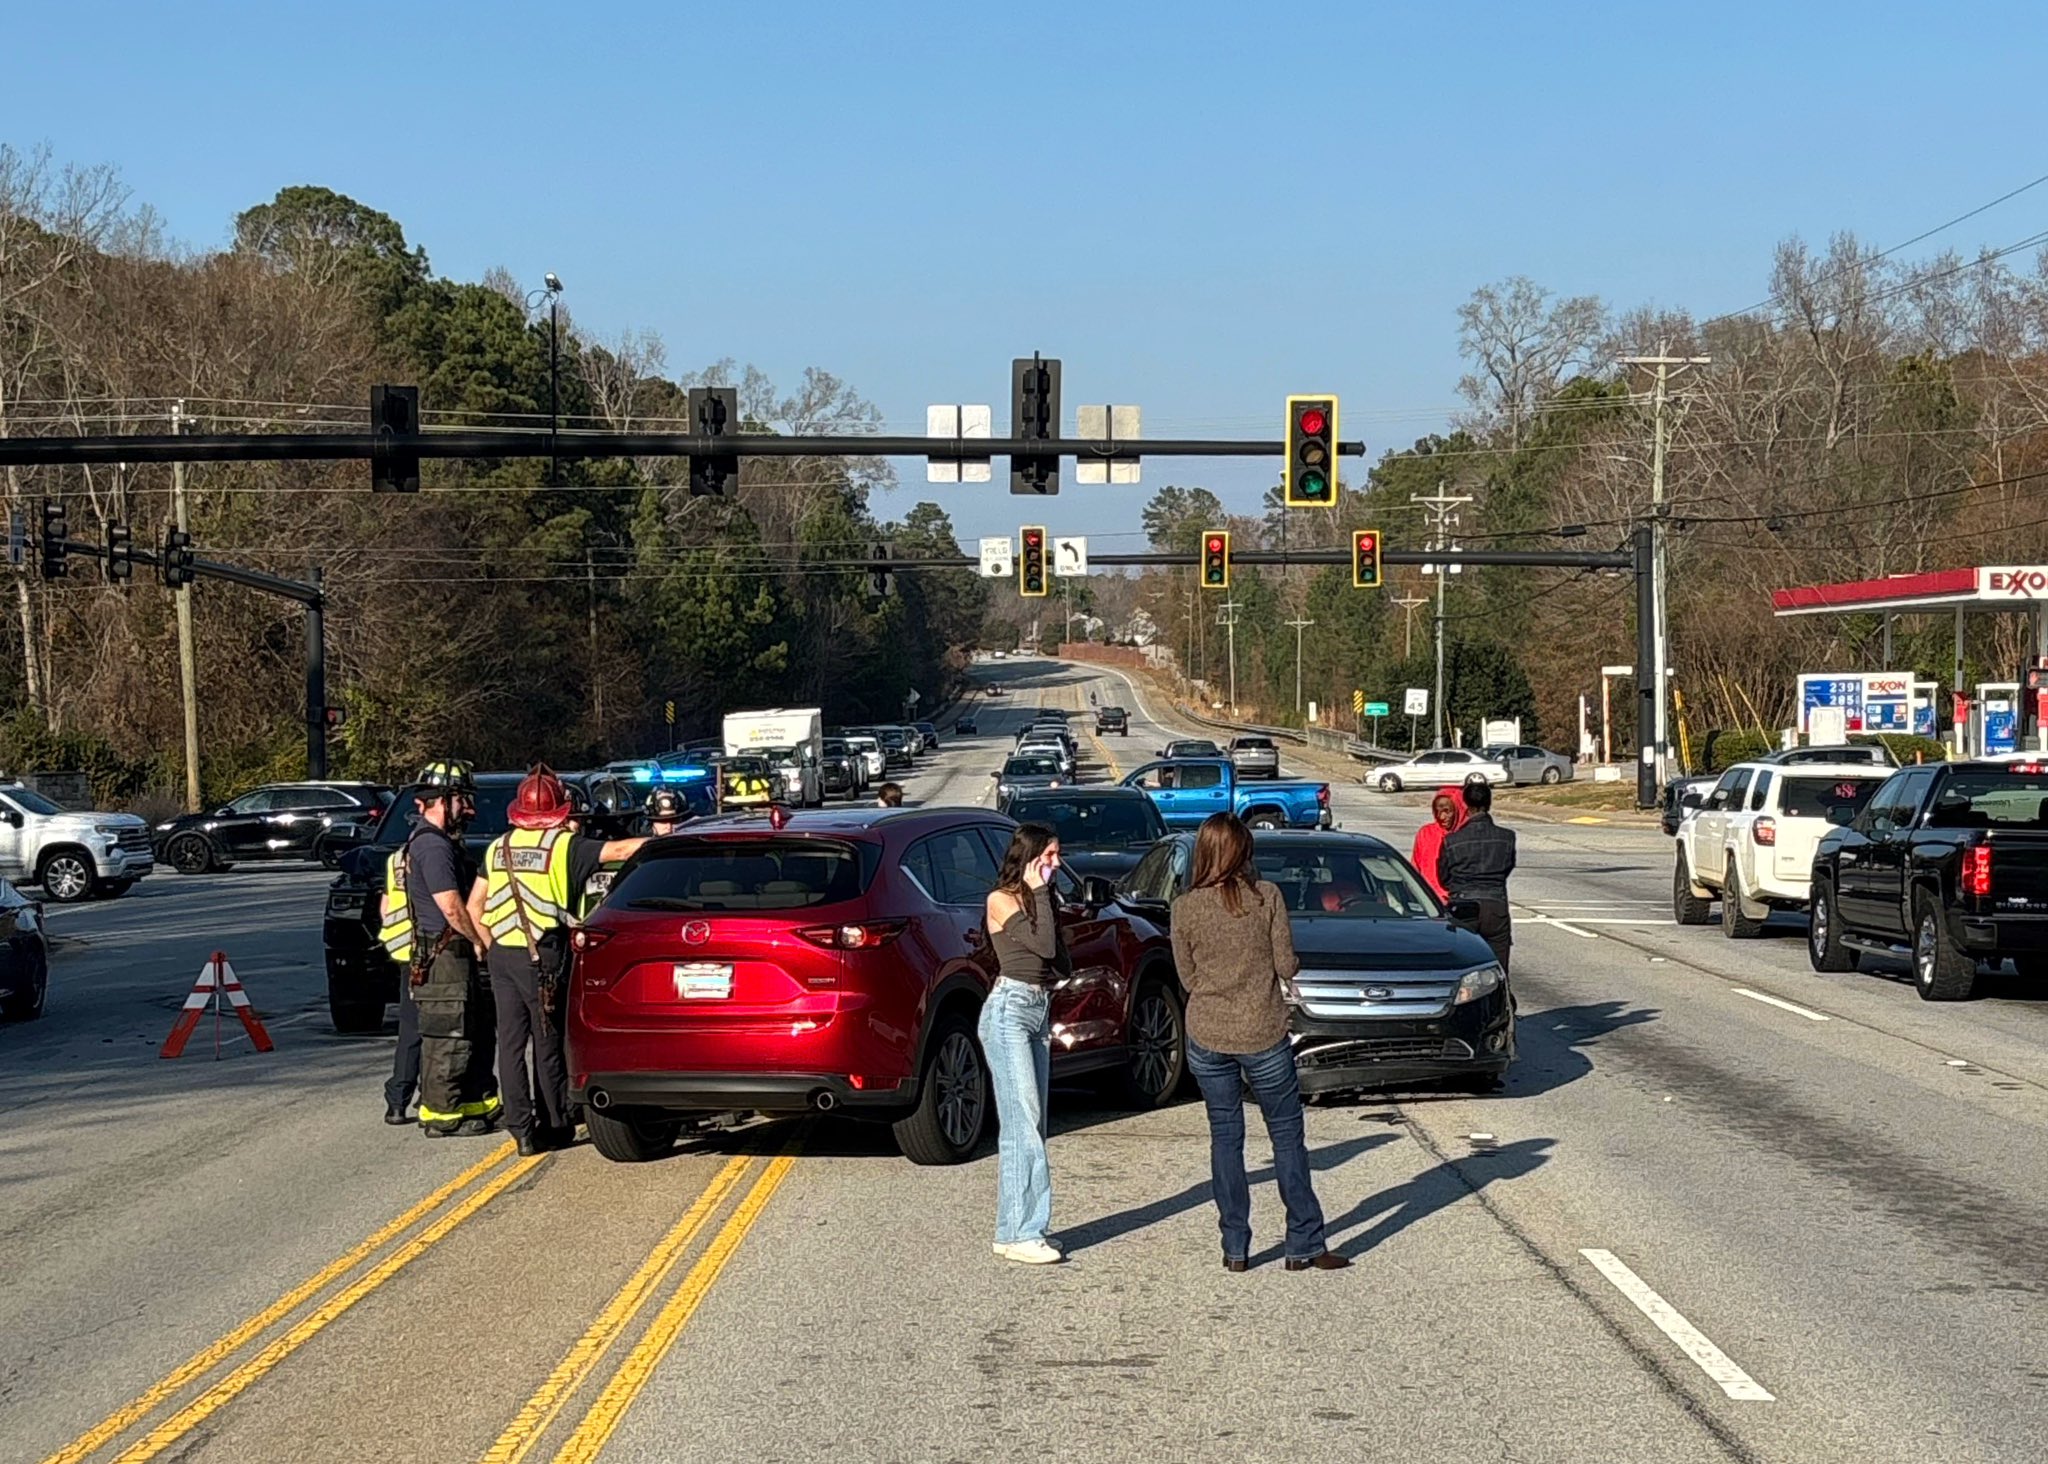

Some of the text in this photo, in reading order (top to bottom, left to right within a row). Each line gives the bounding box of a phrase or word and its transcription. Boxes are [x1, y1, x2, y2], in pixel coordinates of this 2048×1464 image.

[1990, 569, 2048, 598] EXXO
[1868, 681, 1907, 695] EXXON
[1408, 702, 1424, 713] 45
